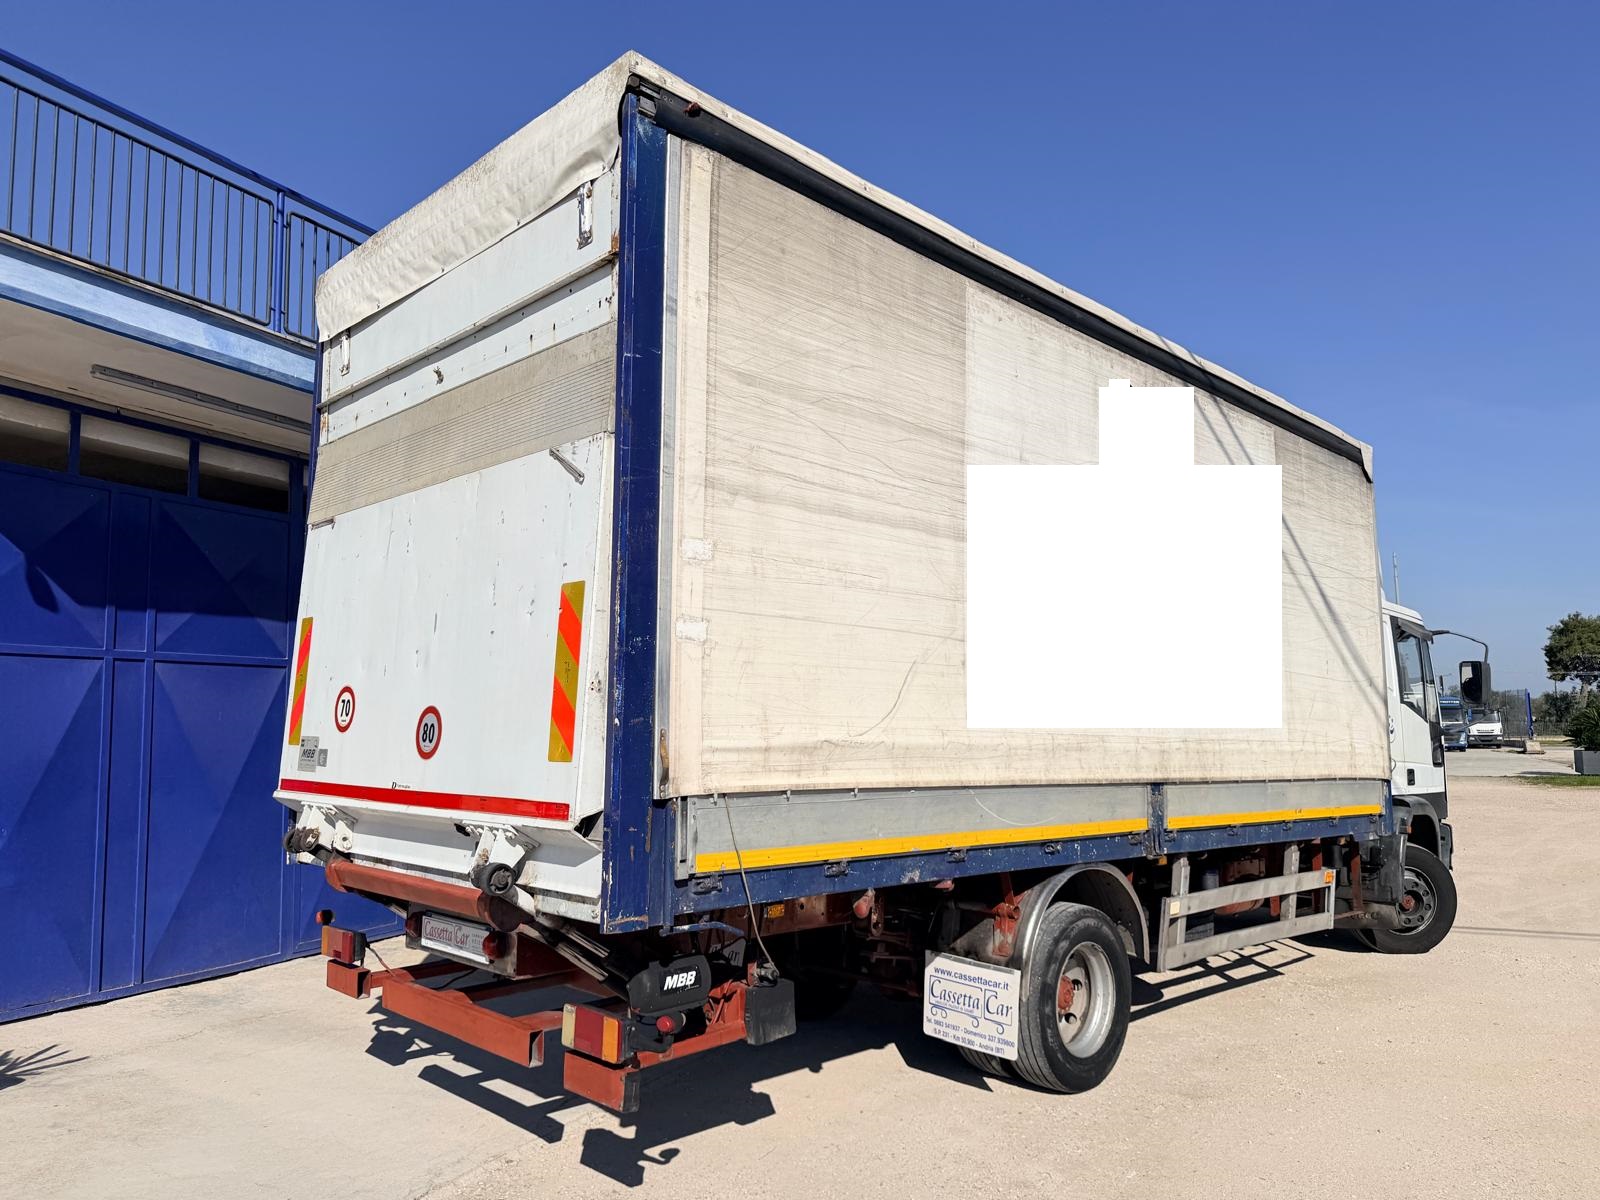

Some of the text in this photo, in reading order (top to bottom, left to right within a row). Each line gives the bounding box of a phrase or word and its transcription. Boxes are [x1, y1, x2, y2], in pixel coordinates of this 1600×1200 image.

[340, 699, 351, 717] 70
[421, 722, 435, 743] 80
[301, 748, 316, 759] MBB
[424, 920, 453, 942] Cassetta
[455, 926, 470, 945] Car
[664, 971, 696, 991] MBB
[934, 967, 1009, 991] www.cassettacar.it
[931, 979, 980, 1010] Cassetta
[985, 994, 1013, 1018] Car
[964, 1028, 986, 1040] Domenico
